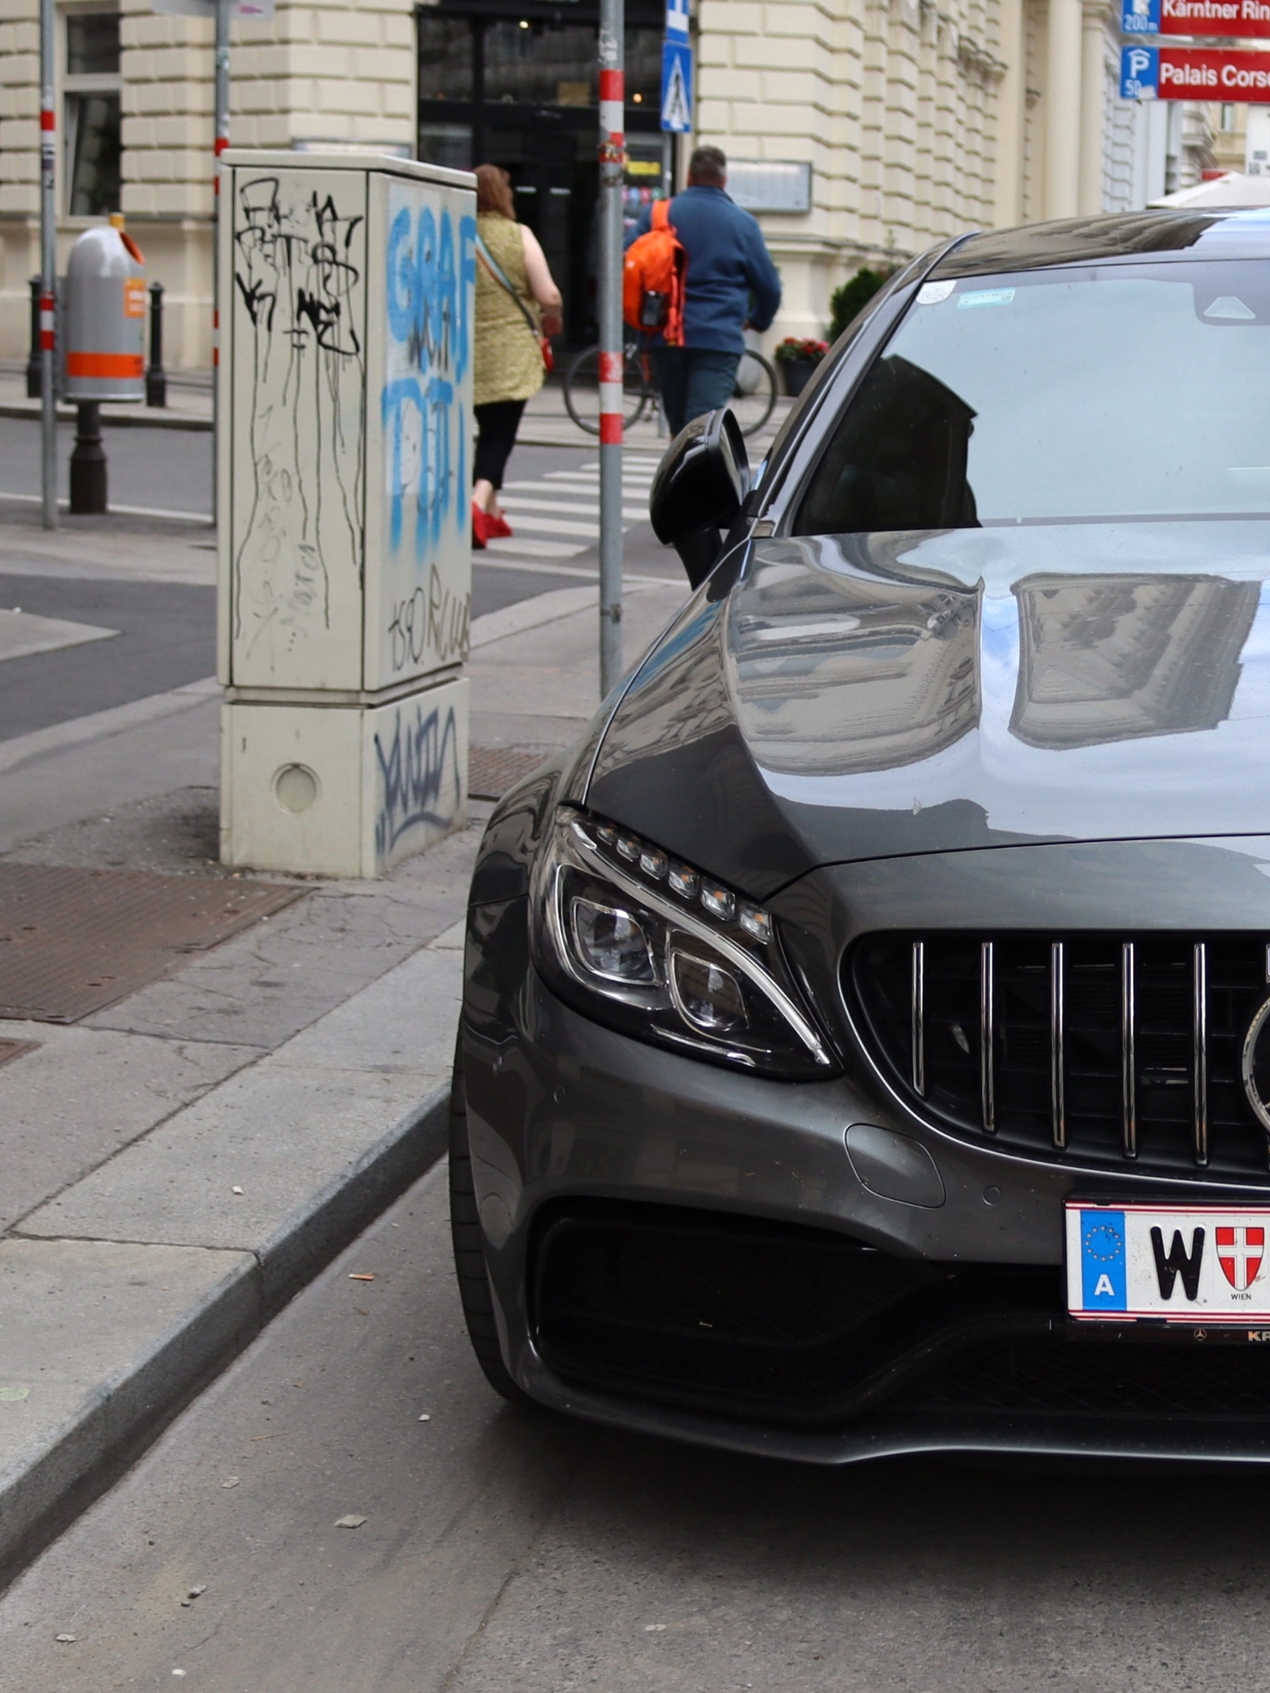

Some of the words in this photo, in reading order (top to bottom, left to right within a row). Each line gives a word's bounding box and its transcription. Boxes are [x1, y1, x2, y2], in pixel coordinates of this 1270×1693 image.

[1162, 0, 1239, 18] Kärntner
[1160, 62, 1217, 85] Palais
[1150, 1225, 1206, 1301] W
[1094, 1273, 1115, 1297] A
